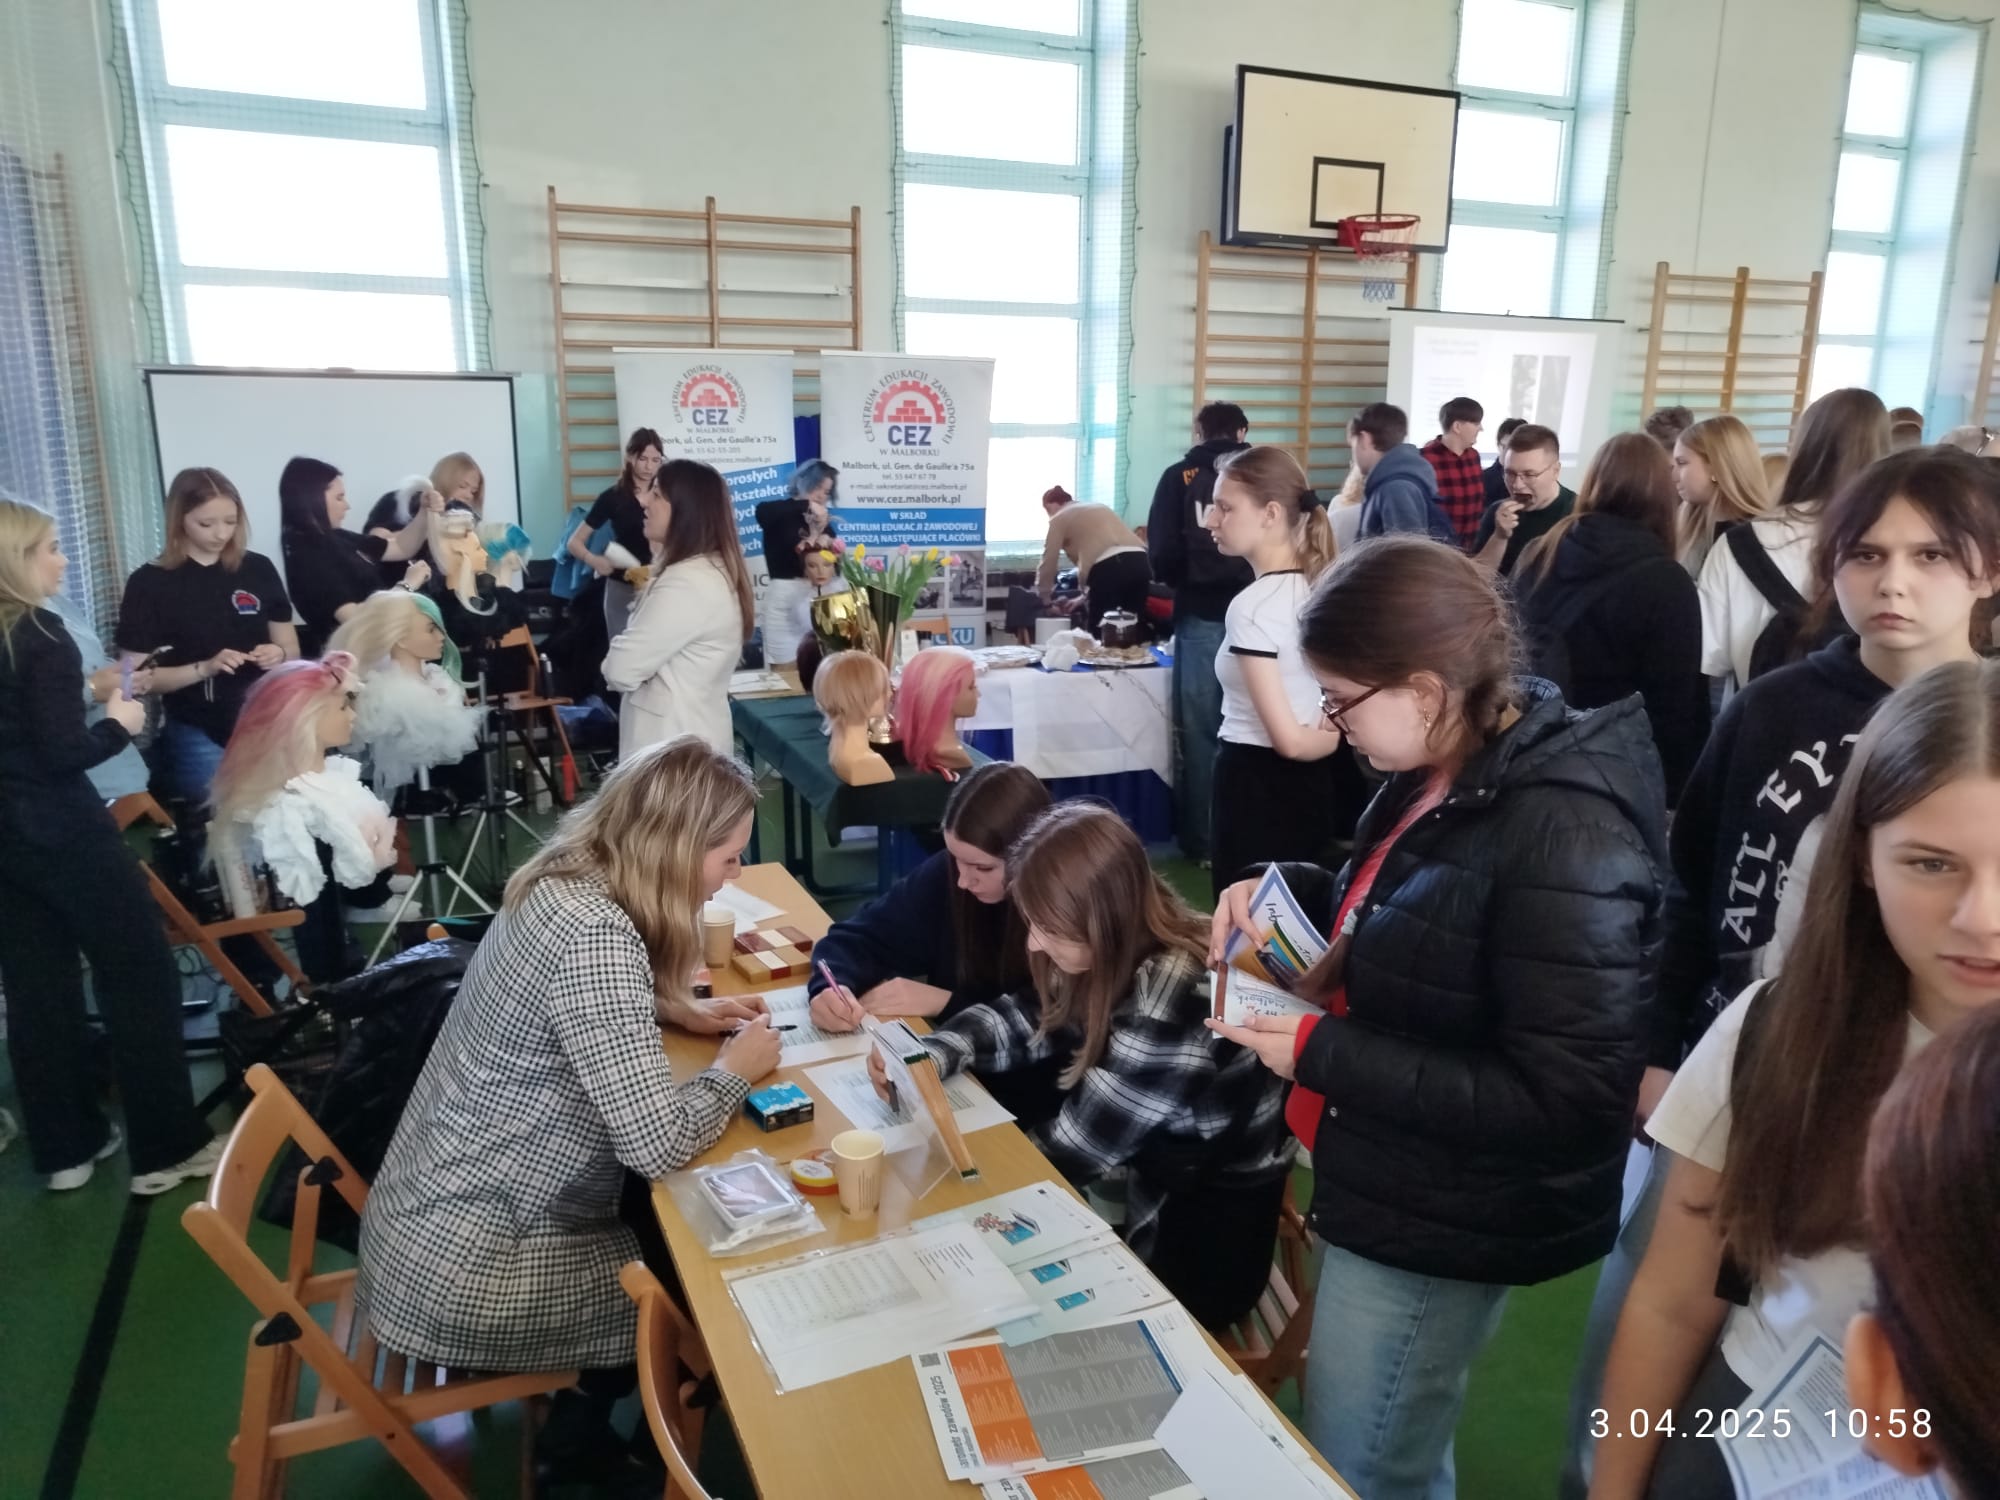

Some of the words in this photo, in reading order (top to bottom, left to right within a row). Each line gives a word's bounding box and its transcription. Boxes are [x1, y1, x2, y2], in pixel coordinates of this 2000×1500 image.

[863, 388, 879, 442] CENTRUM
[880, 369, 928, 388] EDUKACJI
[931, 378, 956, 445] ZAWODOWEJ
[692, 408, 729, 426] CEZ
[663, 437, 682, 446] bork,
[717, 436, 727, 444] de
[887, 425, 932, 446] CEZ
[890, 448, 940, 457] MALBORKU
[842, 462, 880, 471] Malbork,
[882, 462, 892, 470] ul.
[914, 462, 924, 470] de
[926, 462, 958, 470] Gaulle'a
[727, 467, 778, 487] orosłych
[857, 494, 961, 505] www.cez.malbork.pl
[890, 512, 899, 520] W
[899, 512, 927, 520] SKŁAD
[838, 522, 880, 531] CENTRUM
[882, 522, 923, 531] EDUKACJI
[924, 522, 978, 531] ZAWODOWEJ
[881, 534, 937, 545] NASTĘPUJĄCE
[1721, 832, 1777, 944] ALL
[930, 1375, 946, 1396] 2025
[940, 1397, 958, 1434] zawodów
